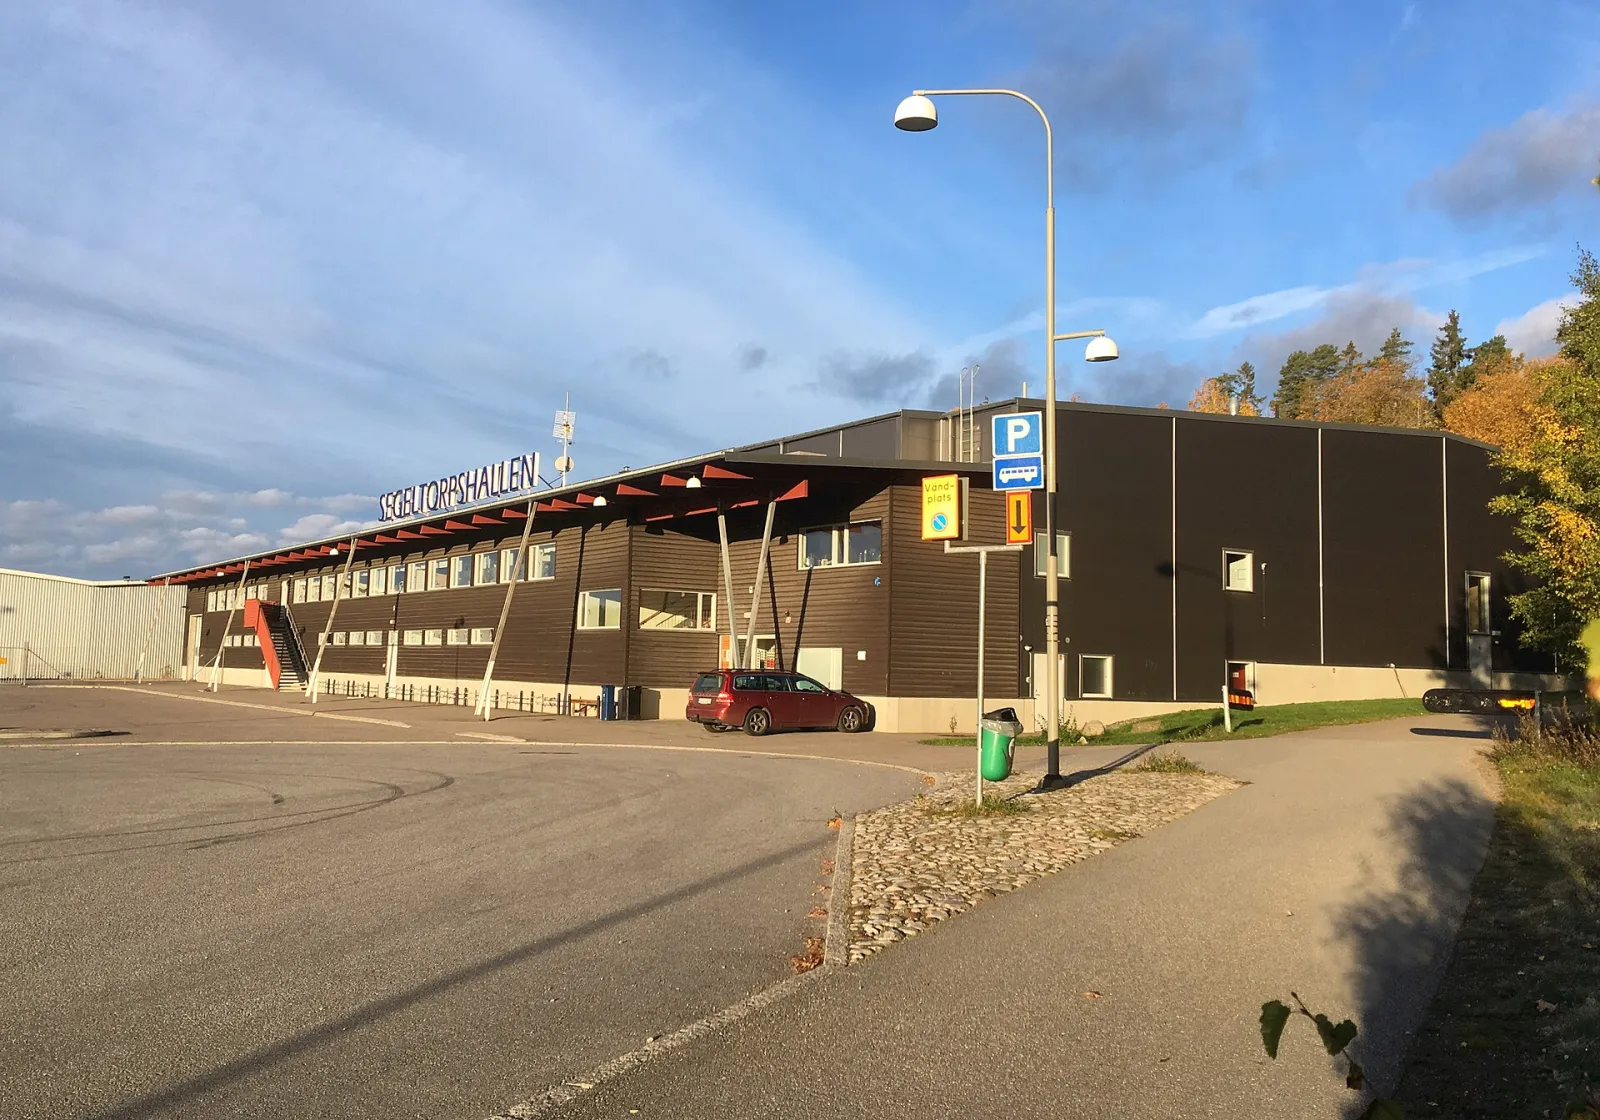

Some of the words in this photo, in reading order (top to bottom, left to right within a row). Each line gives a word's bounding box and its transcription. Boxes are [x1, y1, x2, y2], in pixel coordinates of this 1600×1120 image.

[1007, 418, 1030, 452] P
[378, 452, 539, 522] SEGELTORPSHALLEN
[924, 482, 954, 492] Vänd-
[927, 494, 952, 506] plats
